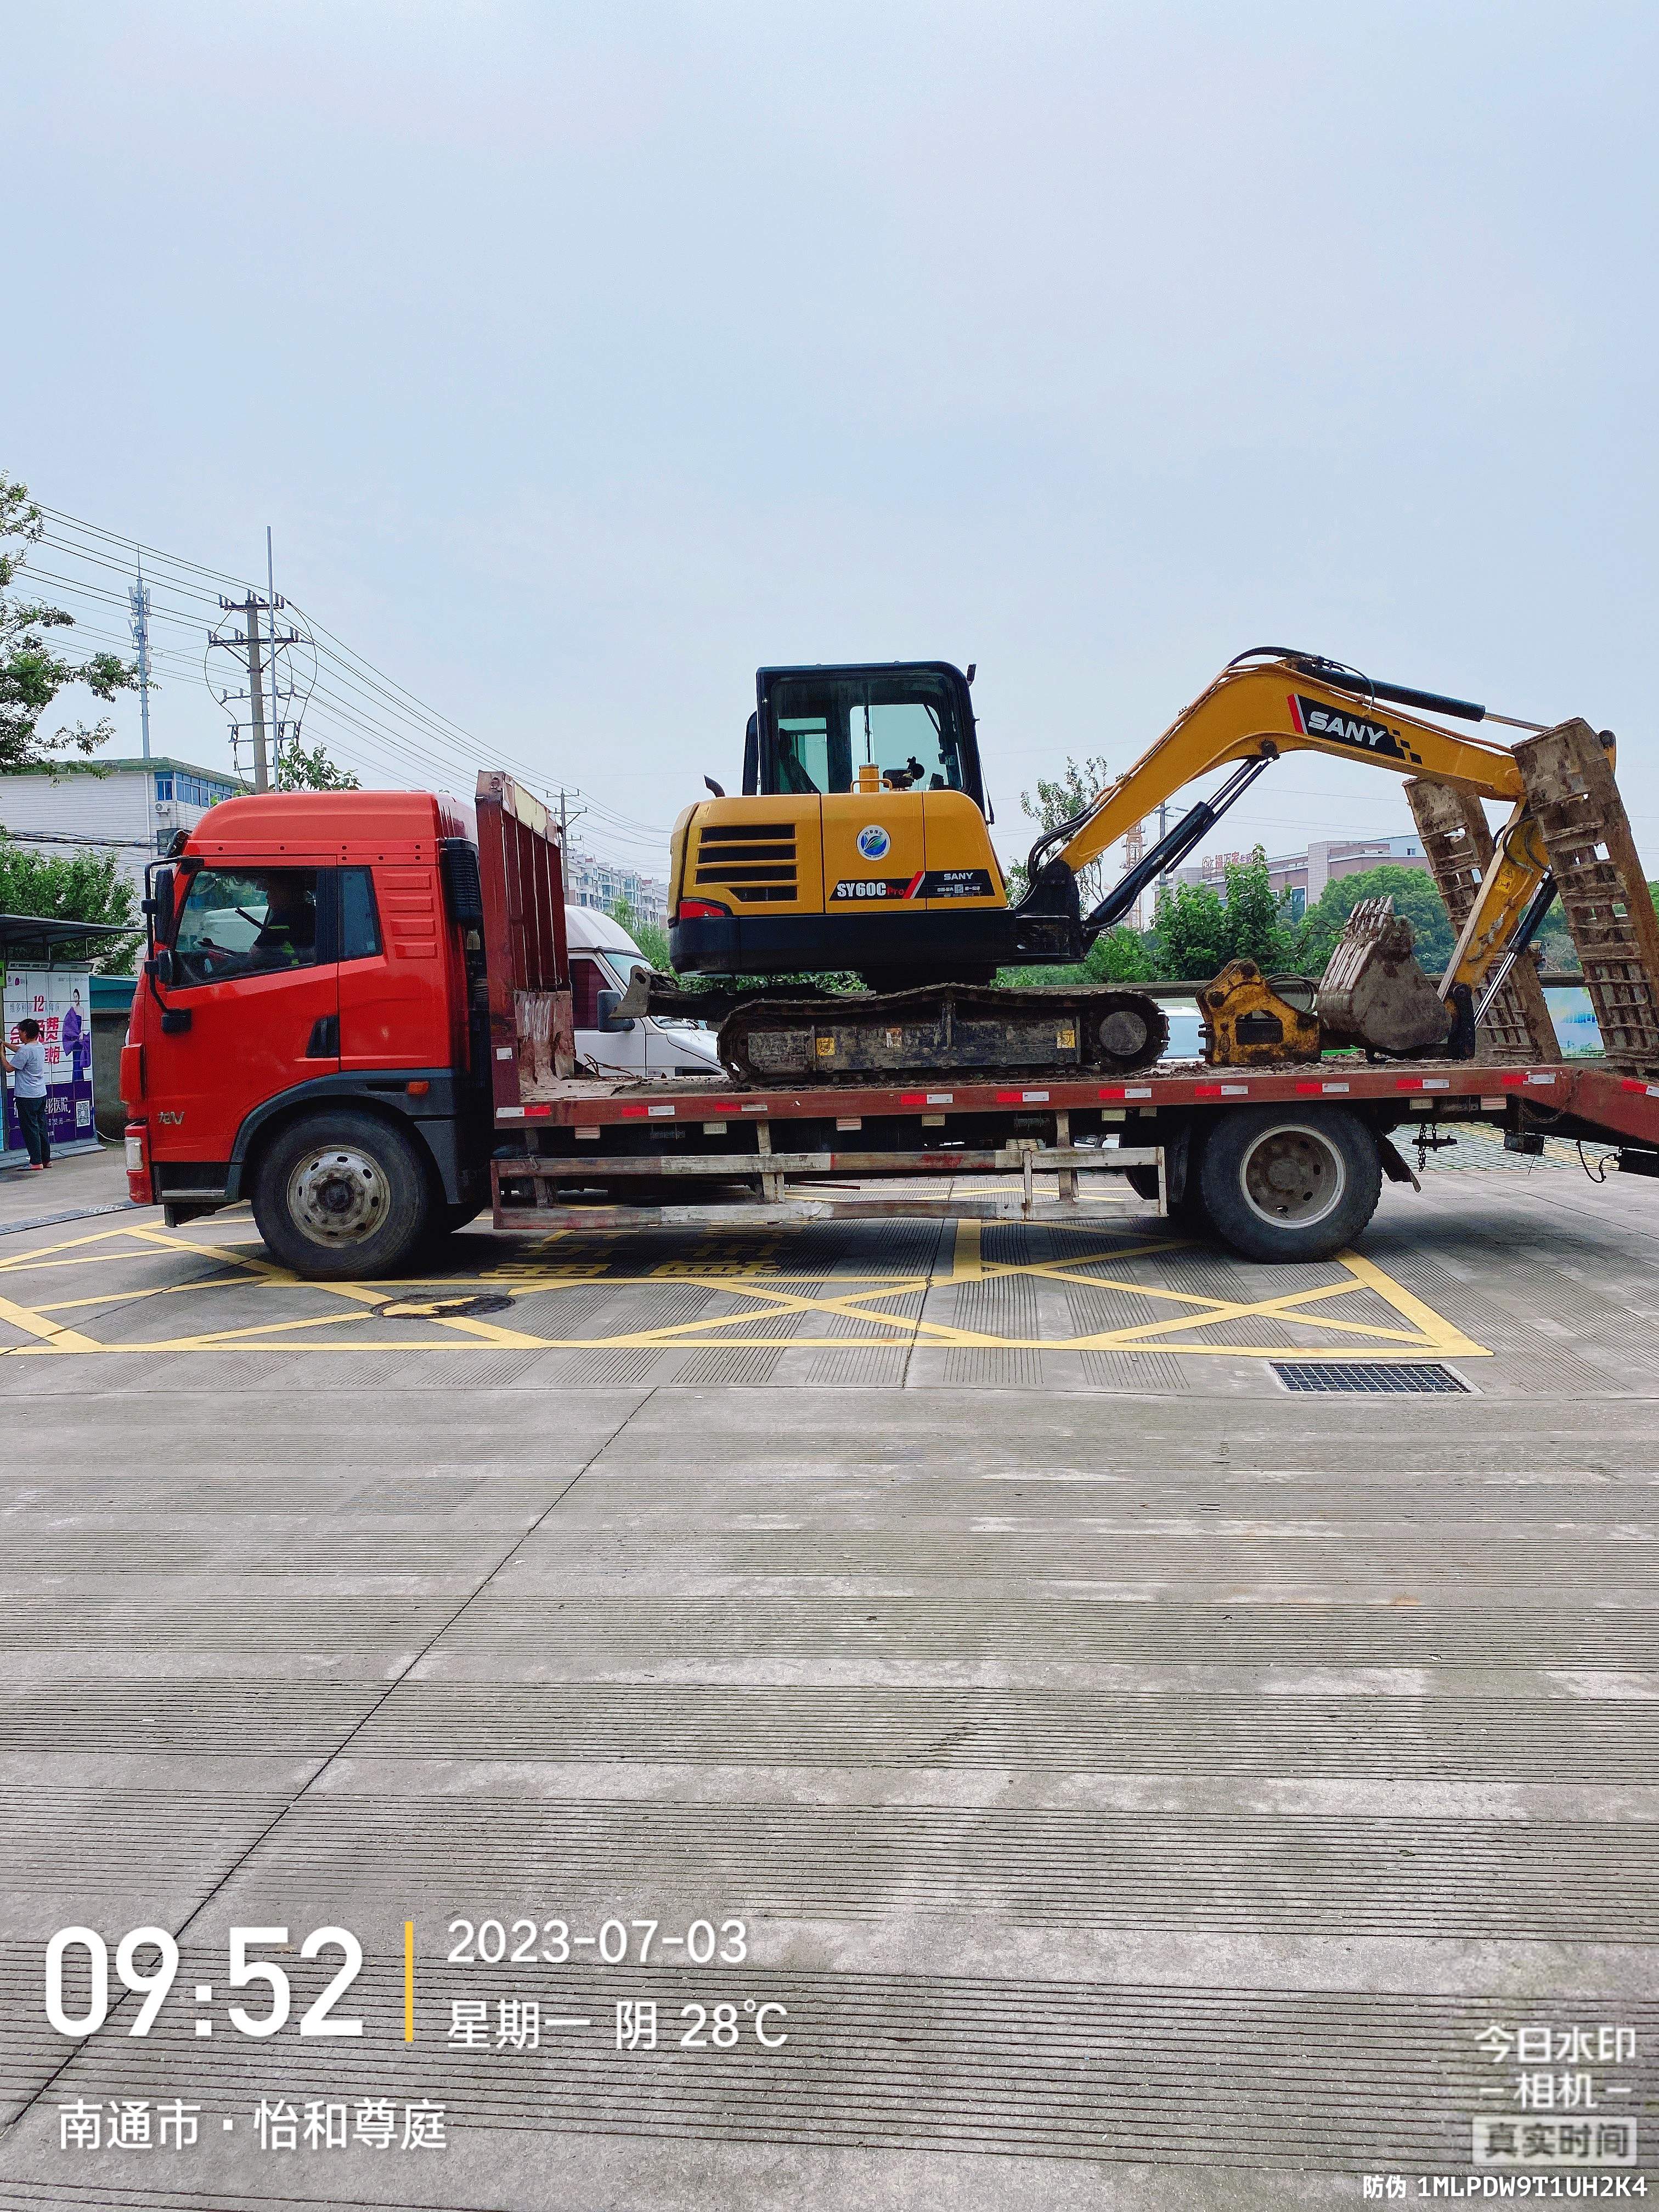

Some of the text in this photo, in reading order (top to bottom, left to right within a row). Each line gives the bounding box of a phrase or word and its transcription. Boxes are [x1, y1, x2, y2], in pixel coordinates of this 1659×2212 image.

[1308, 711, 1386, 746] SANY
[944, 872, 973, 881] SANY
[837, 882, 887, 897] SY60C
